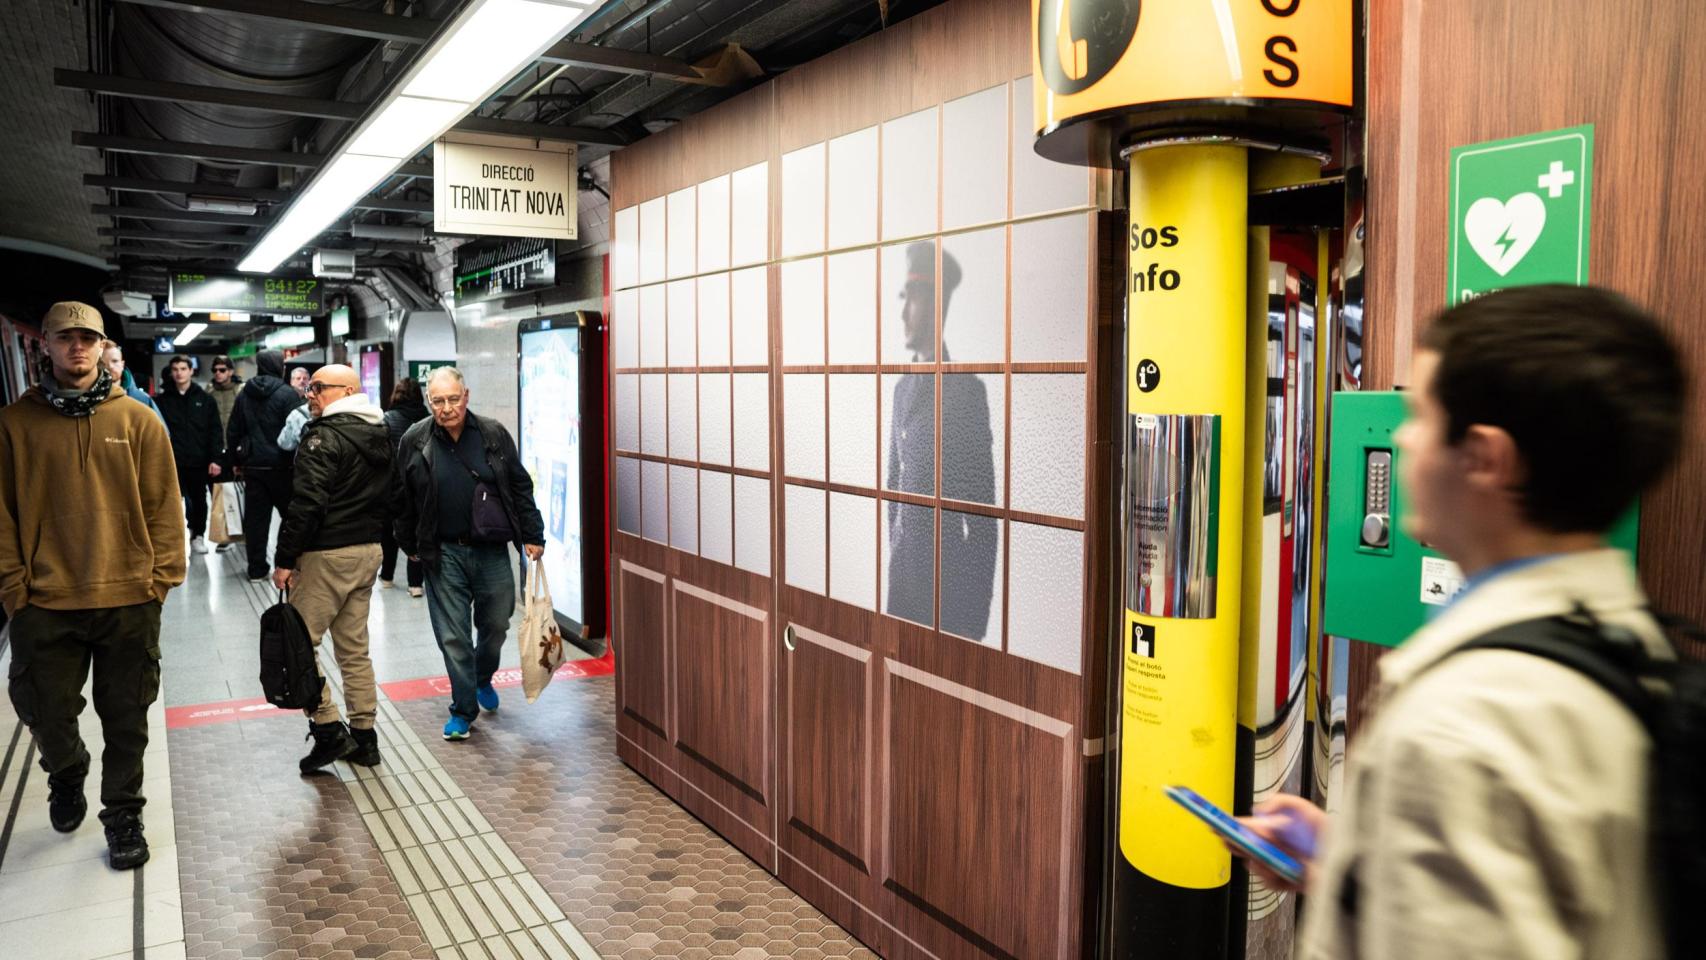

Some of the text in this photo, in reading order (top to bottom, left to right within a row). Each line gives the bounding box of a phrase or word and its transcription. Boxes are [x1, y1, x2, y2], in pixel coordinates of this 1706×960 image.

[482, 164, 534, 182] DIRECCIÓ
[449, 185, 564, 216] TRINITAT NOVA
[1131, 223, 1179, 251] Sos
[264, 279, 317, 294] 04:27
